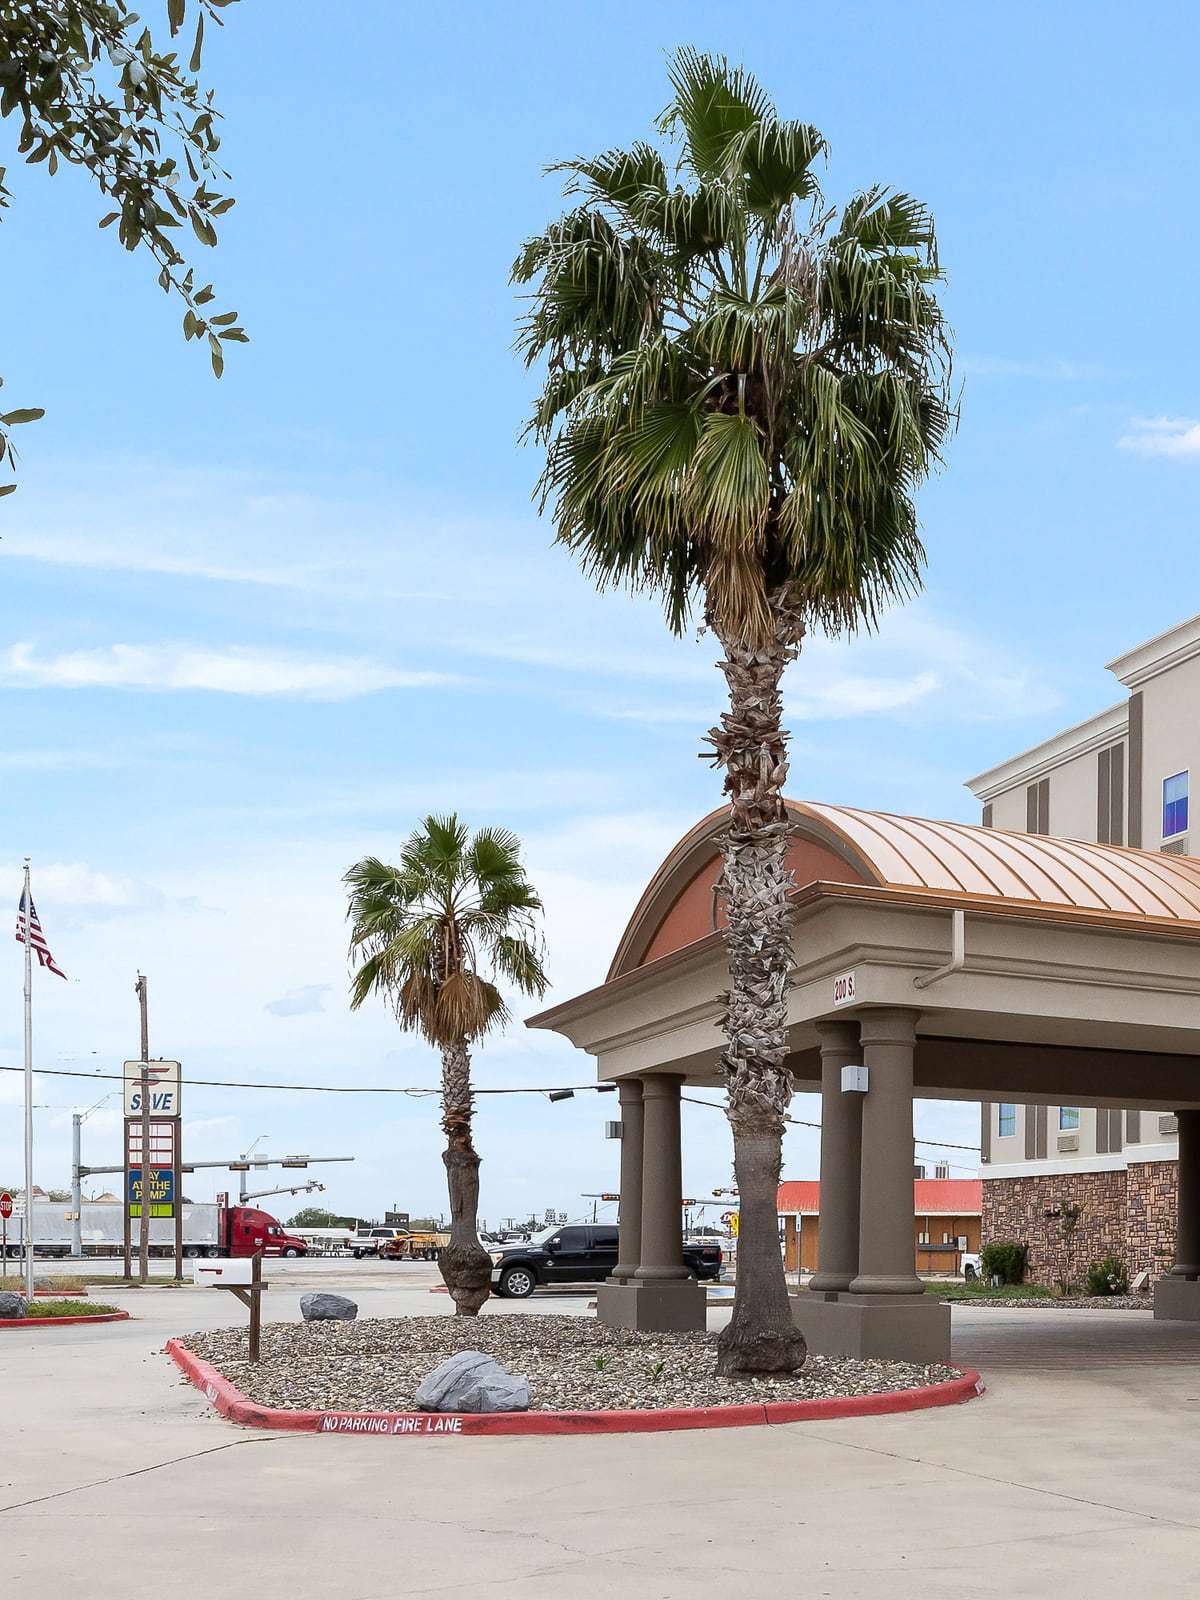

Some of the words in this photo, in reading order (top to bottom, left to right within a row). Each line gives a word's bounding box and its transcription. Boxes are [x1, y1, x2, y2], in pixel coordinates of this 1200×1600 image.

[835, 979, 846, 1000] 200
[130, 1093, 173, 1110] SVE
[149, 1180, 171, 1190] THE
[135, 1190, 166, 1200] PMP
[0, 1201, 12, 1211] STOP
[323, 1416, 338, 1431] NO
[339, 1416, 388, 1432] PARKING
[393, 1417, 424, 1433] FIRE
[427, 1417, 464, 1432] LANE
